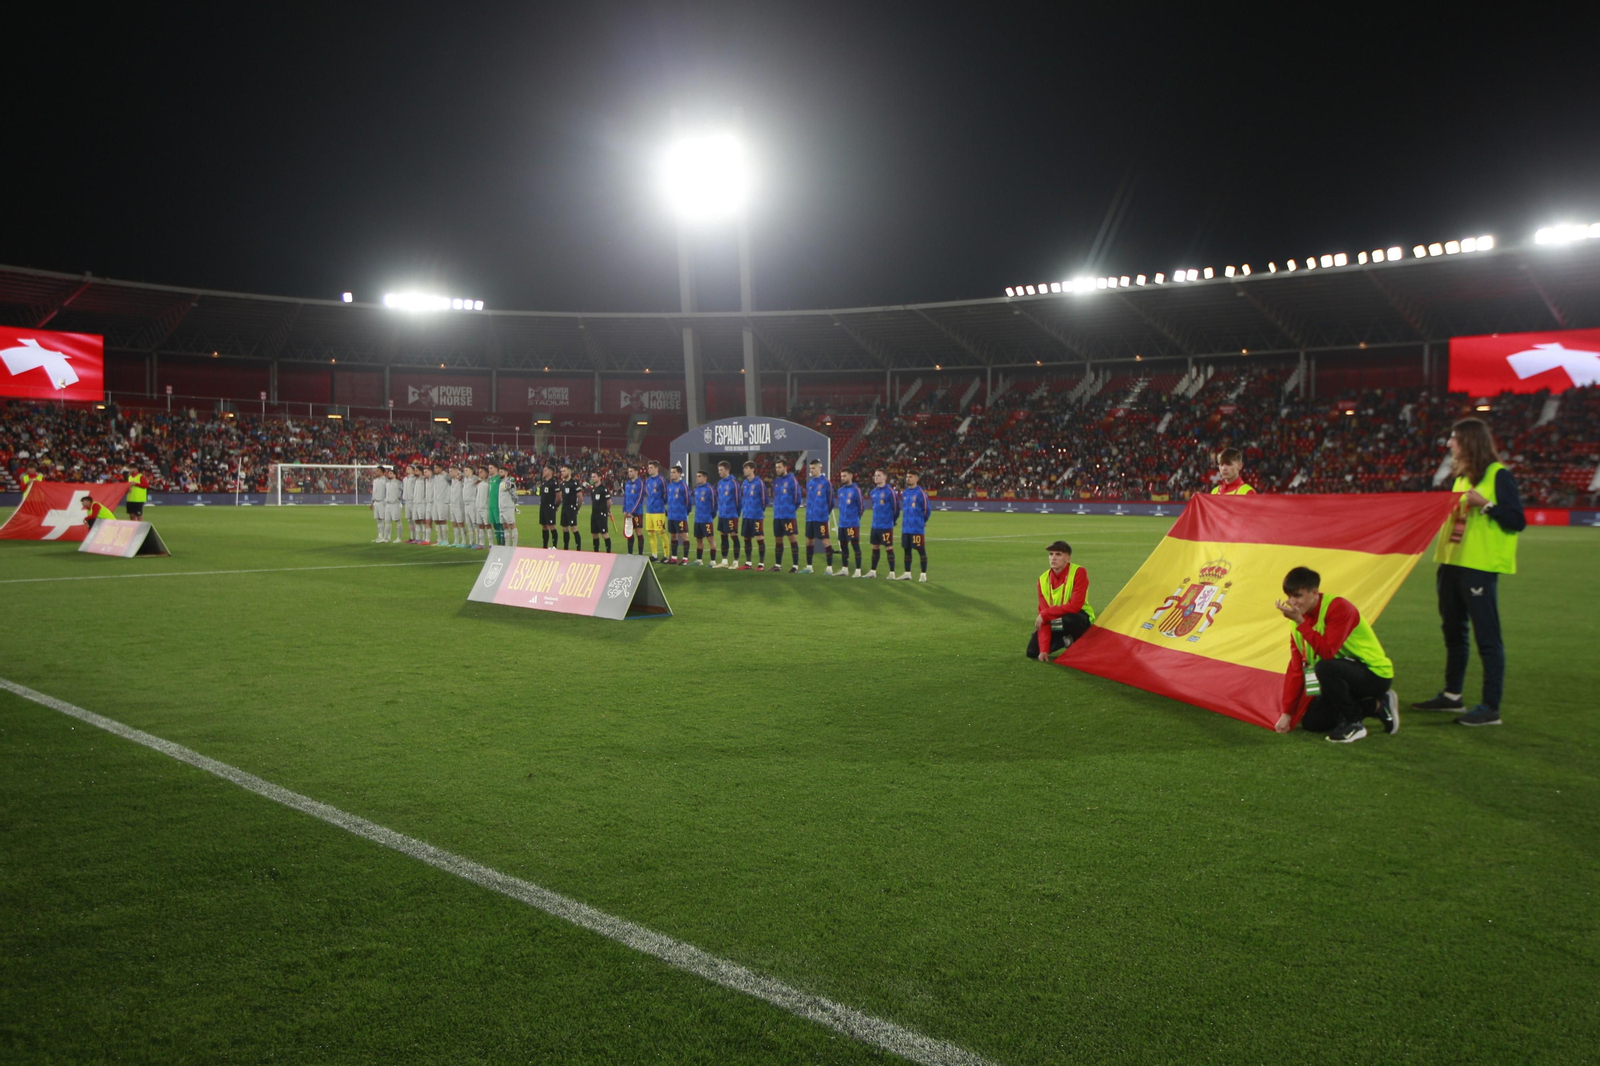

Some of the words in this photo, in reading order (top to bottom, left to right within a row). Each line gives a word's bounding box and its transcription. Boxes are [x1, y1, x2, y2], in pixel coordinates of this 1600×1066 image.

[439, 386, 473, 396] POWER
[650, 390, 681, 400] POWER
[439, 396, 473, 407] HORSE
[650, 399, 682, 410] HORSE
[714, 421, 744, 446] ESPAÑA
[748, 423, 771, 445] SUIZA
[656, 519, 663, 527] 13
[729, 520, 734, 528] 5
[755, 522, 760, 530] 3
[784, 523, 793, 531] 14
[705, 524, 711, 532] 2
[820, 525, 826, 533] 8
[846, 527, 855, 536] 16
[882, 533, 891, 541] 17
[912, 535, 921, 544] 10
[507, 554, 560, 594] ESPAÑA
[558, 562, 602, 599] SUIZA
